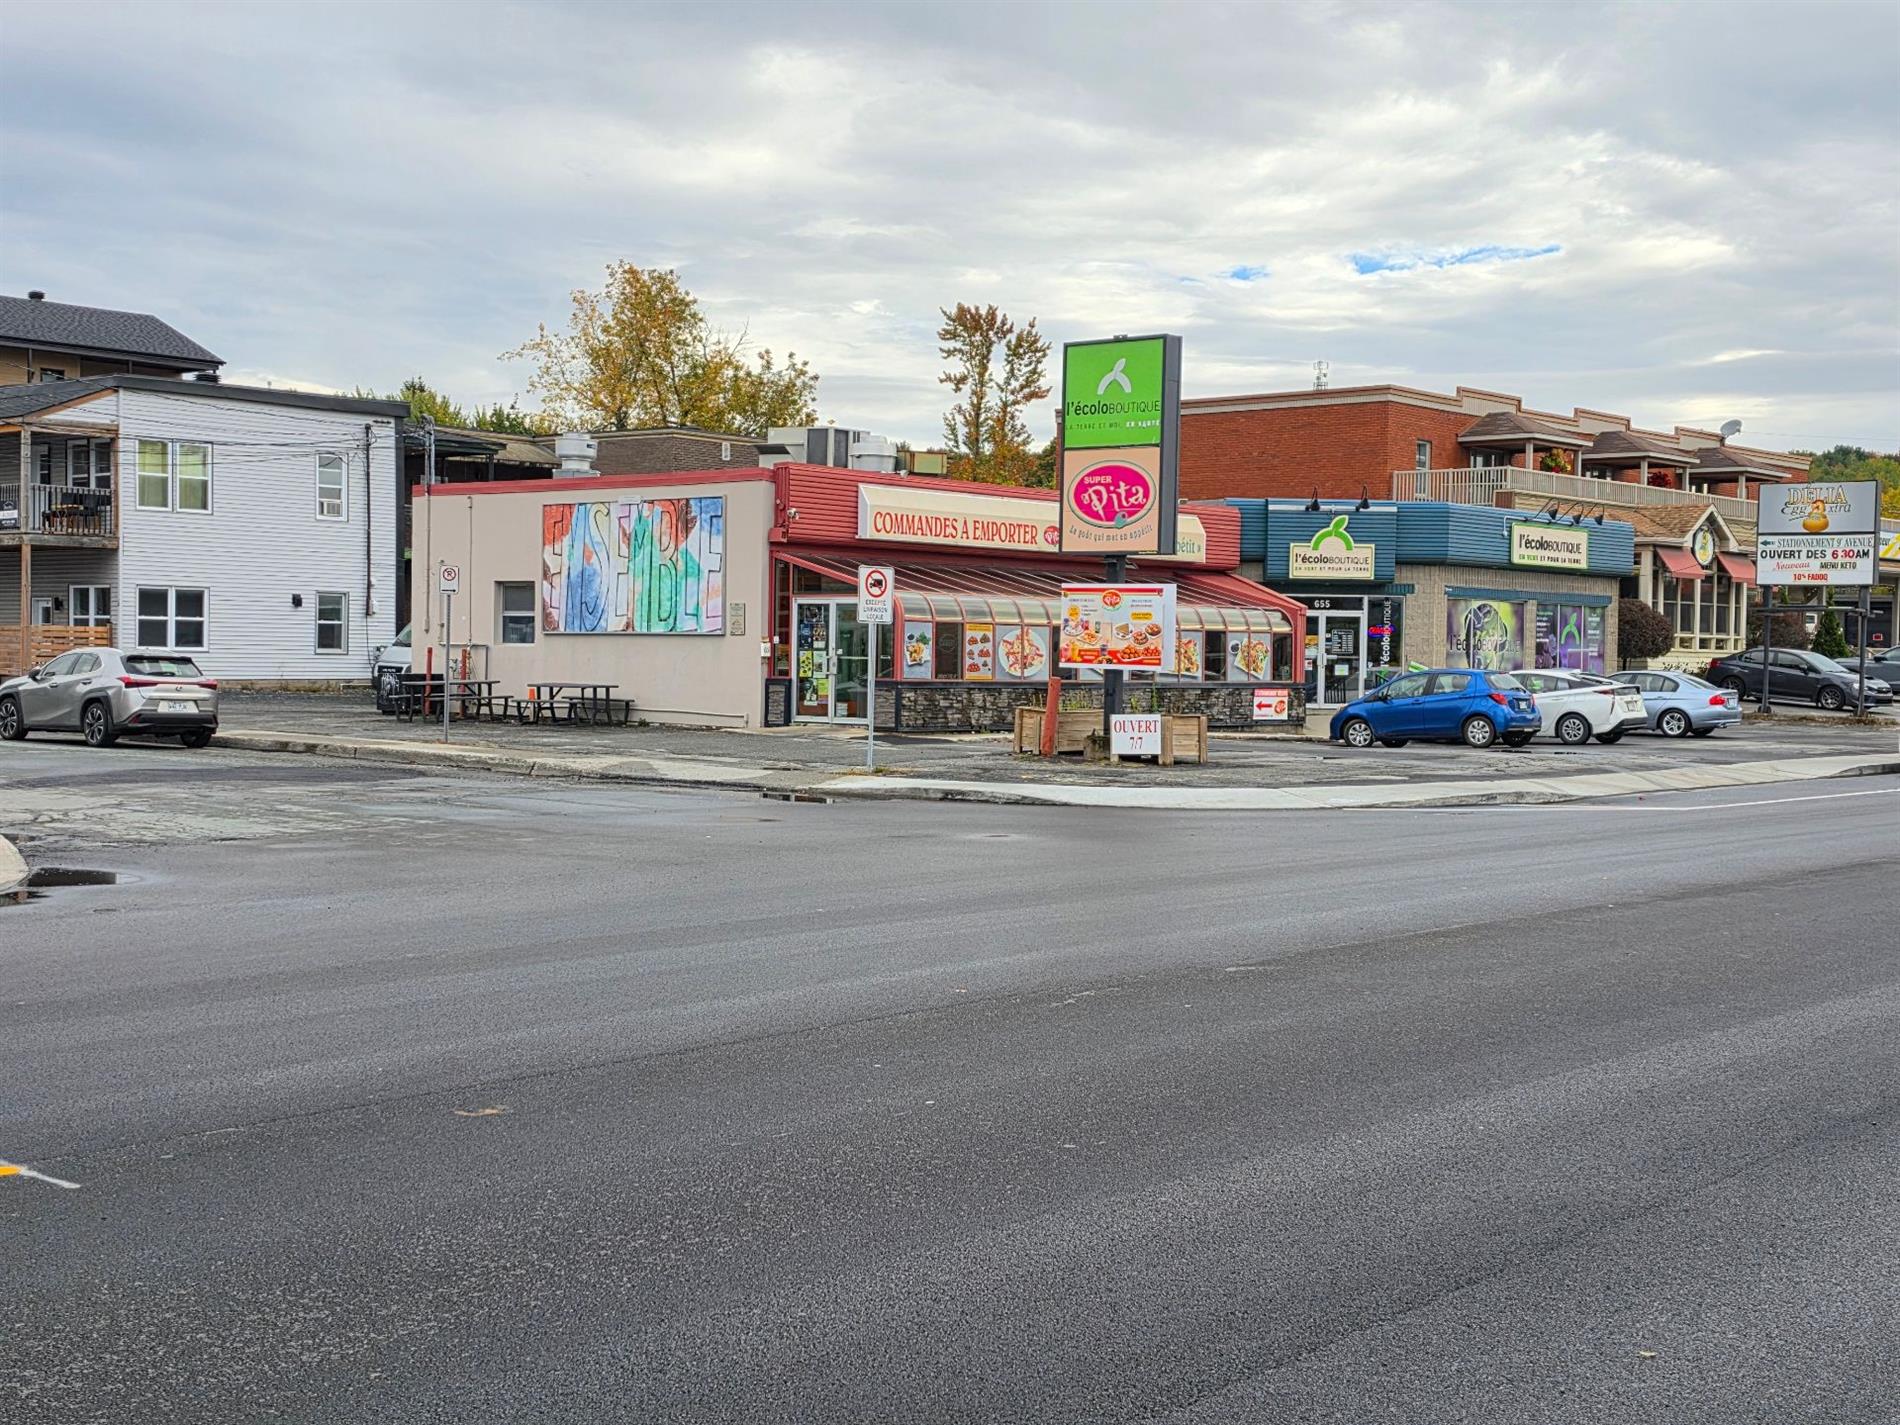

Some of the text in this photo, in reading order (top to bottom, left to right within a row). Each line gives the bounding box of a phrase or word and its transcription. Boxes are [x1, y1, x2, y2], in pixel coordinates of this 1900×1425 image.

[1084, 475, 1112, 484] SUPER
[1081, 481, 1147, 522] Pita
[873, 511, 1038, 545] COMMANDES À EMPORTER
[1777, 538, 1837, 548] STATIONNEMENT
[1844, 537, 1873, 547] AVENUE
[1760, 549, 1802, 559] OUVERT
[1806, 549, 1827, 559] DES
[543, 498, 723, 634] ENSEMBLE
[1820, 561, 1839, 570] MENU
[1840, 561, 1857, 570] KETO
[1314, 600, 1331, 608] 655
[1113, 719, 1160, 733] OUVERT
[1129, 736, 1143, 749] 7/7
